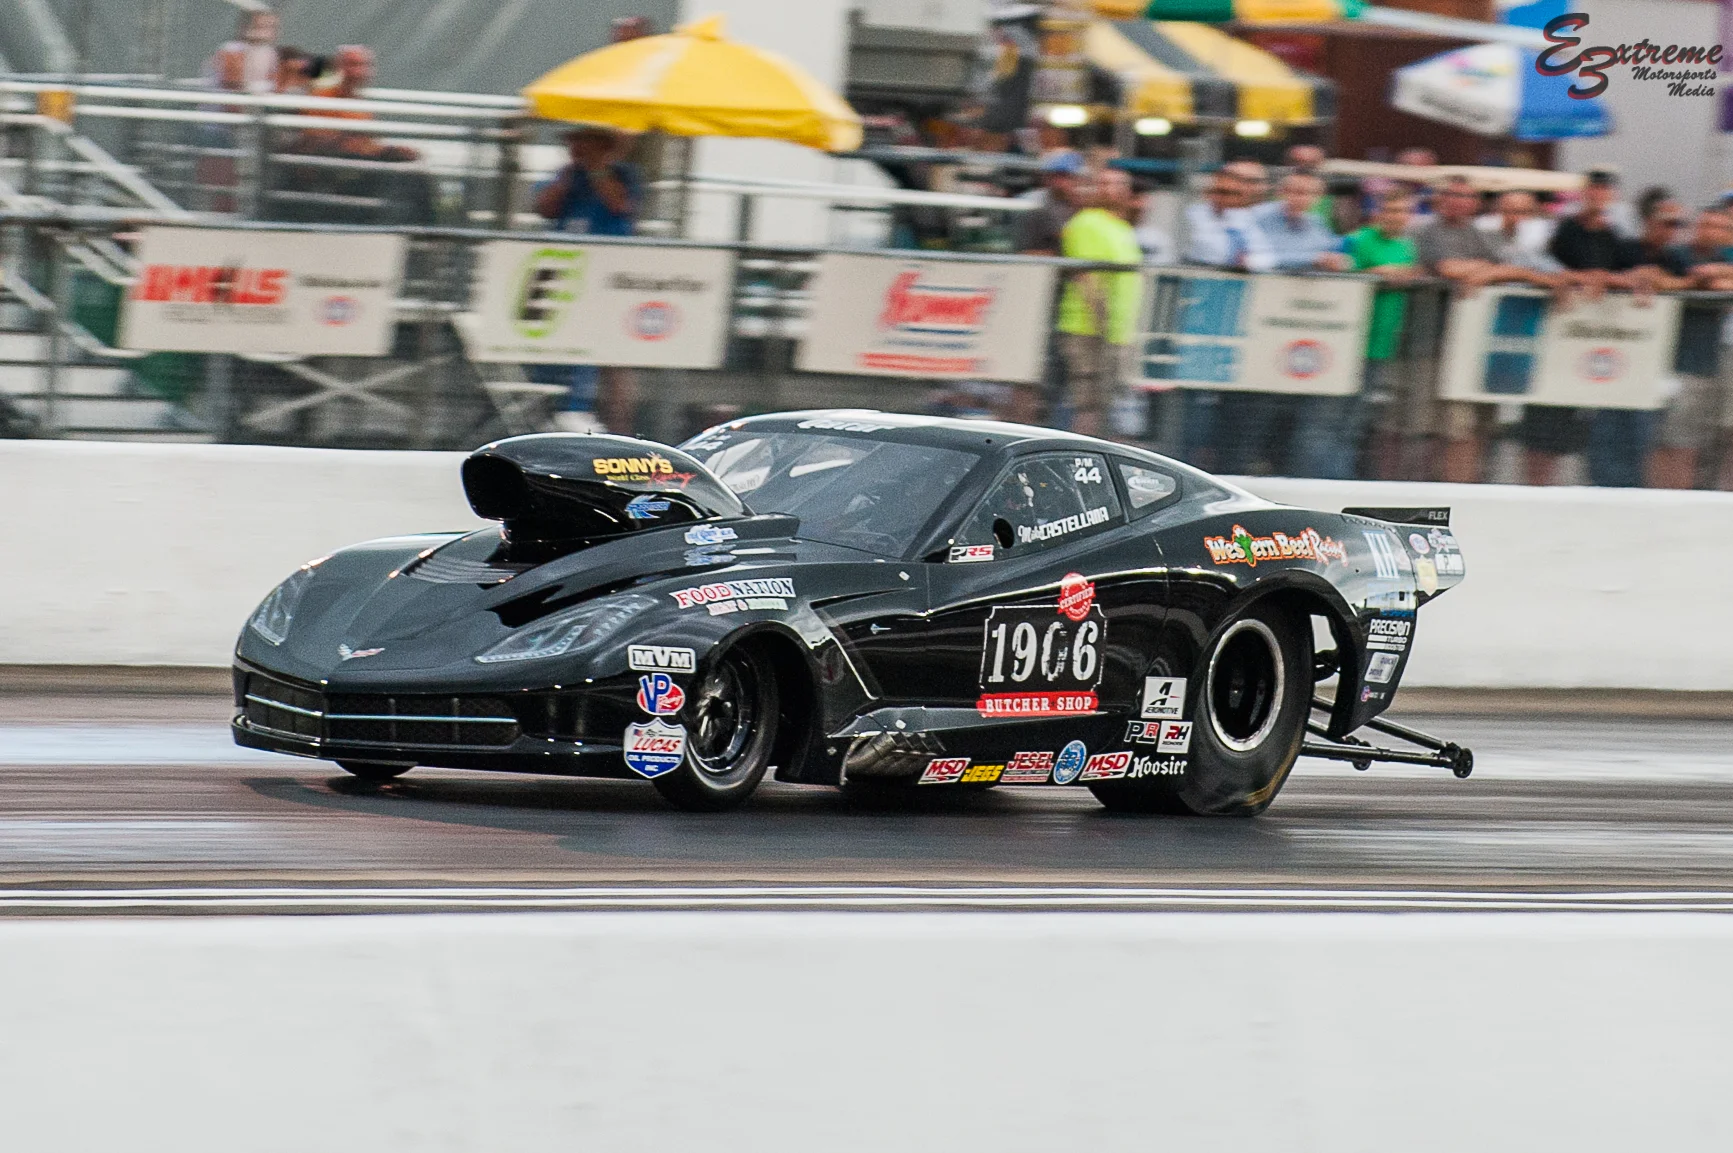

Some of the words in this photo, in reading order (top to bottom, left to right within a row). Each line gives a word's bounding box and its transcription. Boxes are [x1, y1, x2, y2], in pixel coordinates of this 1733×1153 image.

[593, 457, 673, 474] SONNY'S
[1074, 458, 1093, 468] P/M
[1074, 468, 1102, 484] 44
[1428, 511, 1448, 520] FLEX
[1369, 619, 1410, 636] PRECISION
[632, 646, 692, 668] MVM
[639, 674, 673, 713] VP
[985, 698, 1050, 713] BUTCHER
[1057, 697, 1092, 711] SHOP
[633, 737, 681, 752] LUCAS
[925, 760, 967, 776] MSD
[1007, 752, 1053, 770] JESEL
[1086, 754, 1129, 772] MSD
[1127, 755, 1188, 778] Hoosier
[961, 765, 1004, 782] JEGS
